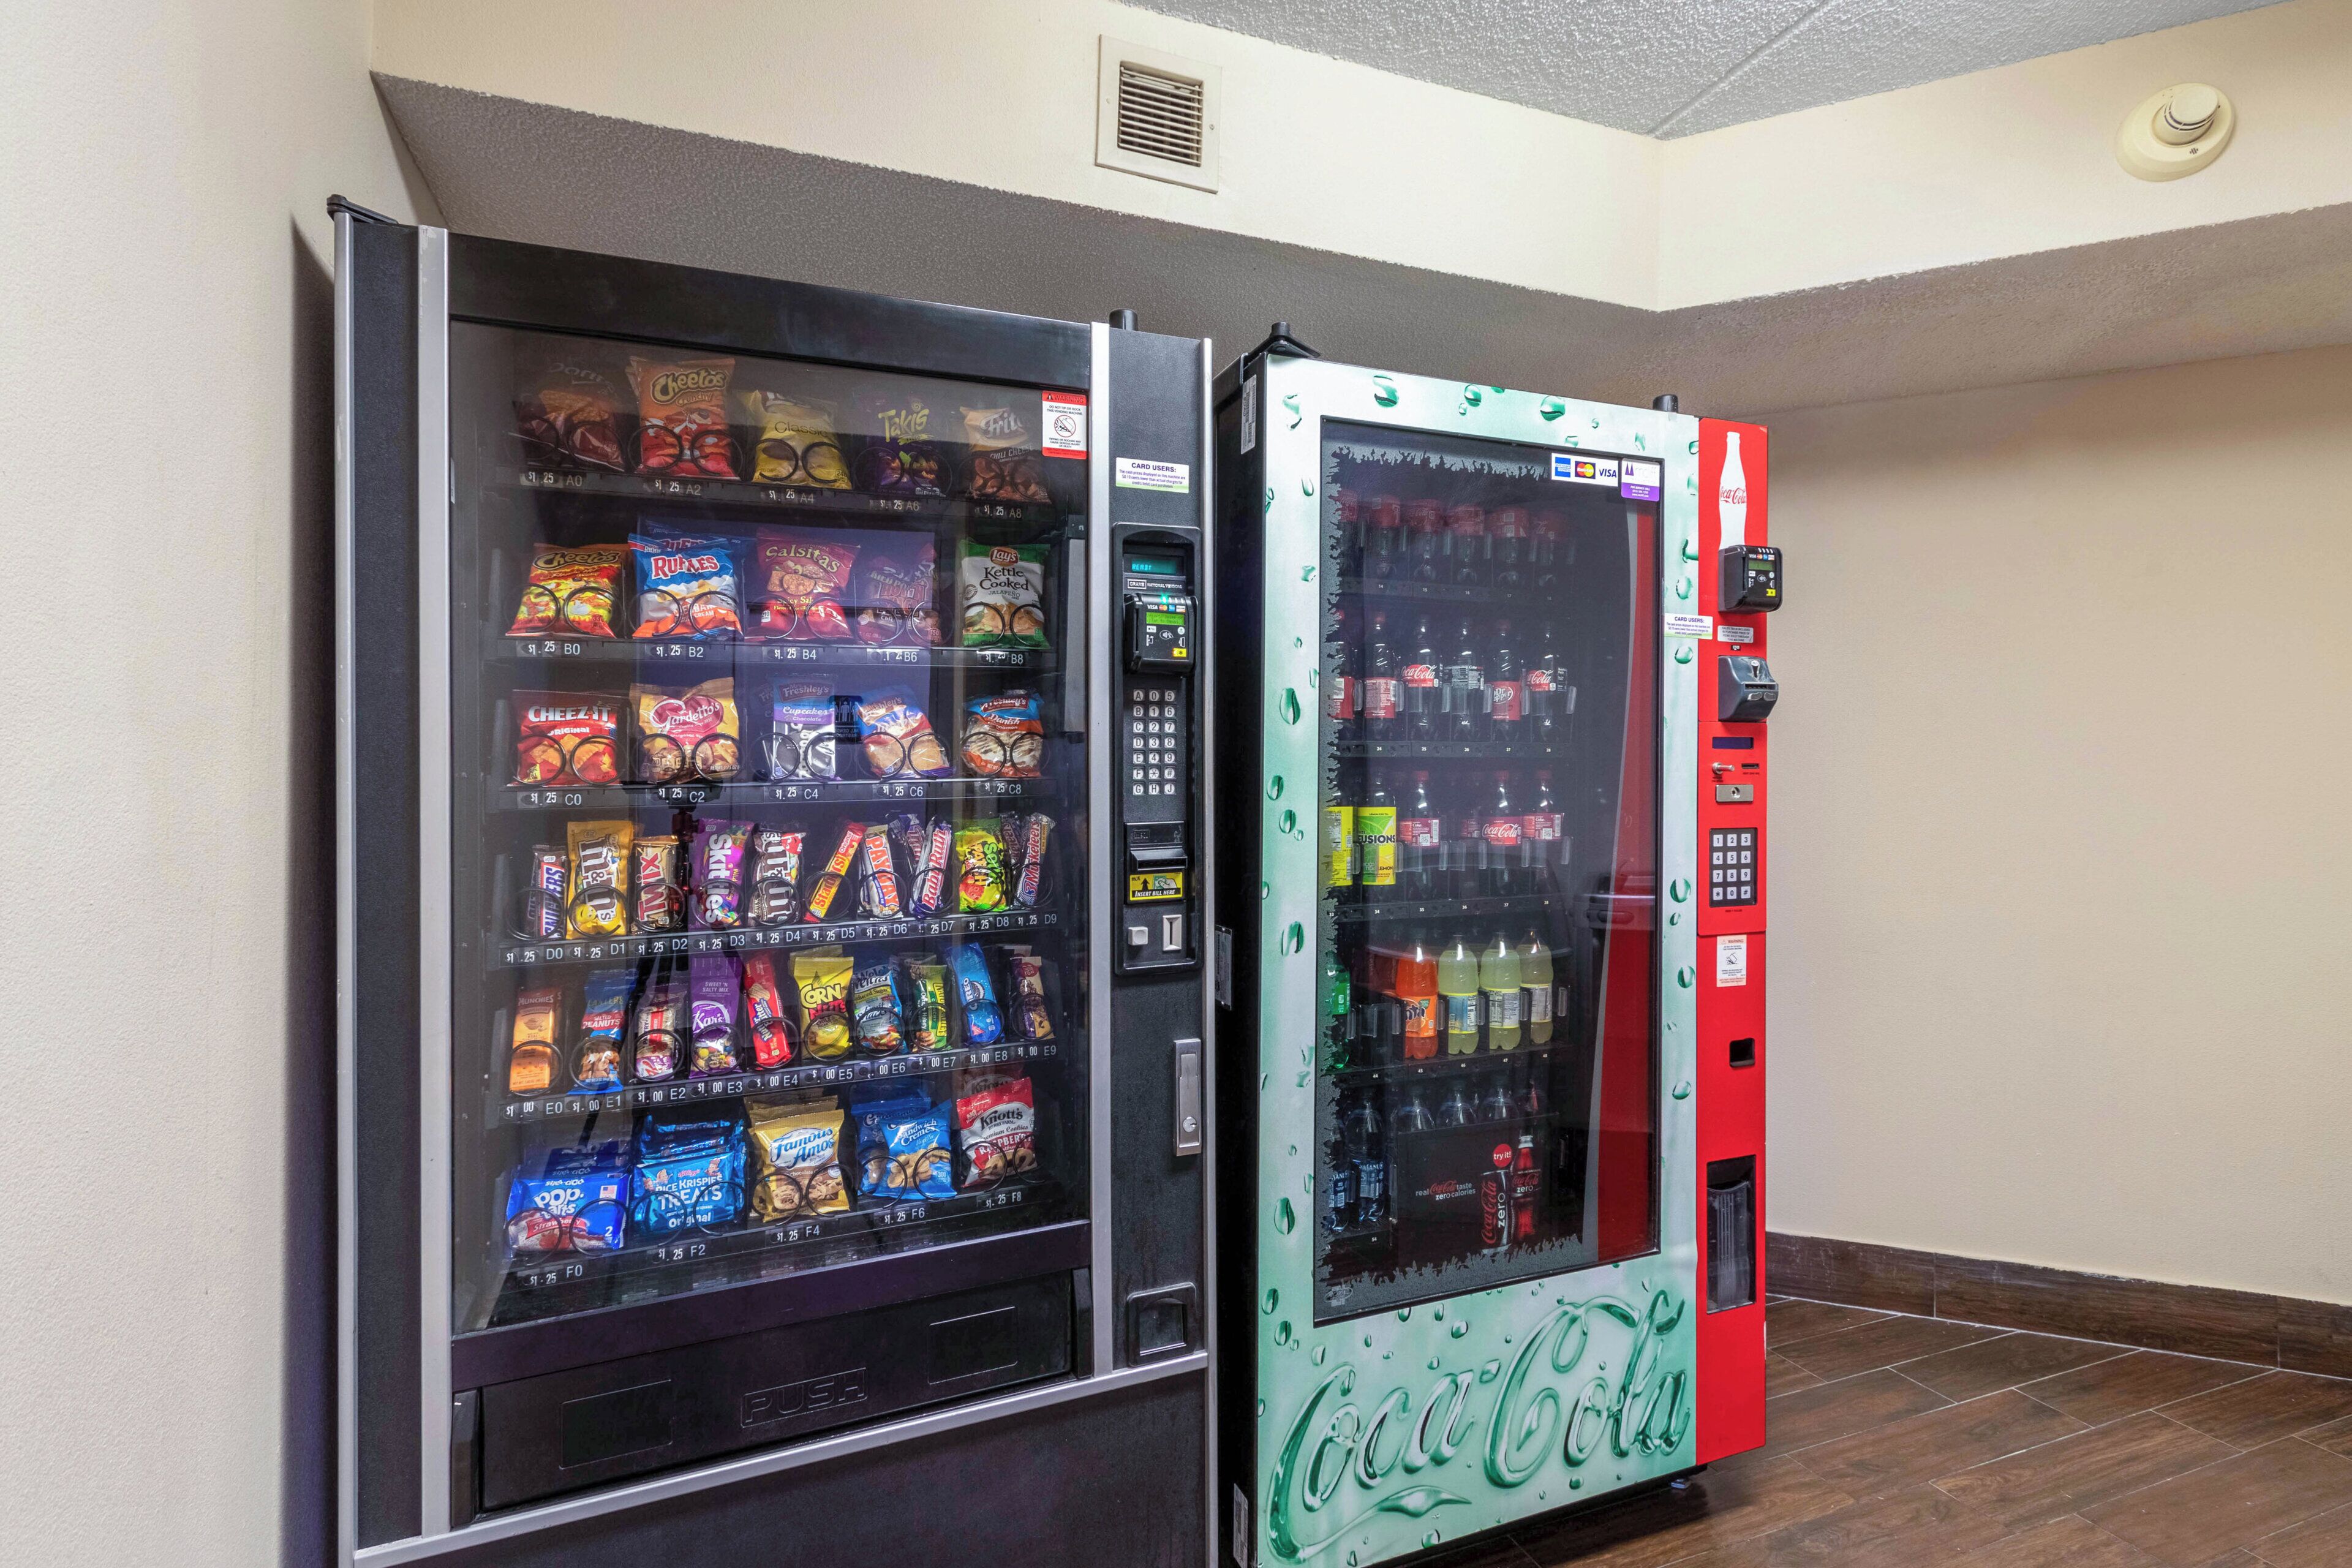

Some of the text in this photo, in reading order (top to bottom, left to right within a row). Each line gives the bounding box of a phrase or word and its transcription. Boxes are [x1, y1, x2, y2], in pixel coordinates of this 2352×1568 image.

[651, 368, 728, 403] Cheetos
[676, 391, 713, 405] Crunchy
[1055, 394, 1084, 403] WARNING
[878, 402, 930, 442] Takis
[775, 421, 827, 437] Classic
[1599, 469, 1616, 478] VISA
[567, 477, 582, 486] A0
[687, 484, 701, 496] A2
[800, 494, 814, 503] A4
[907, 501, 919, 511] A6
[1009, 508, 1022, 518] A8
[532, 551, 620, 570] Cheetos
[766, 545, 840, 572] Galsitas
[992, 549, 1017, 563] Lay's
[984, 567, 1024, 578] Kettle
[980, 579, 1029, 590] Cooked
[565, 644, 580, 655] B0
[689, 647, 703, 658] B2
[802, 650, 816, 660] B4
[905, 652, 917, 662] B6
[1011, 654, 1023, 664] B8
[783, 685, 829, 697] Freshley's
[529, 706, 611, 722] CHEEZ-IT
[650, 699, 720, 734] Gardetto's
[783, 706, 827, 717] Cupcakes
[989, 714, 1020, 725] Danish
[805, 789, 818, 799] C4
[910, 786, 923, 796] C6
[1009, 785, 1021, 794] C8
[565, 794, 582, 805] C0
[690, 792, 704, 802] C2
[839, 831, 853, 853] Original
[865, 836, 900, 907] PAYDAY
[706, 834, 733, 922] Skittles
[997, 918, 1009, 926] D8
[1045, 914, 1057, 923] D9
[894, 924, 907, 934] D6
[941, 921, 953, 930] D7
[786, 932, 800, 941] D4
[842, 929, 854, 938] D5
[673, 939, 687, 949] D2
[730, 935, 745, 946] D3
[546, 948, 563, 959] D0
[611, 943, 625, 954] D1
[518, 995, 554, 1006] MUNCHIES
[800, 984, 842, 1009] CORN
[583, 1018, 620, 1028] PEANUTS
[693, 1011, 725, 1030] Kar's
[995, 1051, 1008, 1061] E8
[1044, 1046, 1056, 1055] E9
[892, 1063, 905, 1072] E6
[943, 1057, 956, 1067] E7
[784, 1076, 797, 1085] E4
[839, 1071, 853, 1079] E5
[728, 1082, 742, 1093] E3
[671, 1088, 685, 1099] E2
[607, 1096, 620, 1107] E1
[546, 1102, 562, 1114] E0
[981, 1108, 1023, 1131] Knott's
[988, 1121, 1001, 1131] BERRY
[771, 1127, 833, 1163] Famous
[788, 1139, 835, 1169] Amos
[679, 1175, 723, 1189] KRISPIES
[658, 1185, 722, 1210] TREATS
[1012, 1192, 1021, 1202] F8
[1452, 1189, 1476, 1197] calories
[912, 1208, 924, 1218] F6
[605, 1226, 612, 1237] 2
[806, 1226, 820, 1237] F4
[691, 1245, 705, 1256] F2
[567, 1265, 582, 1278] F0
[745, 1370, 867, 1423] PUSH
